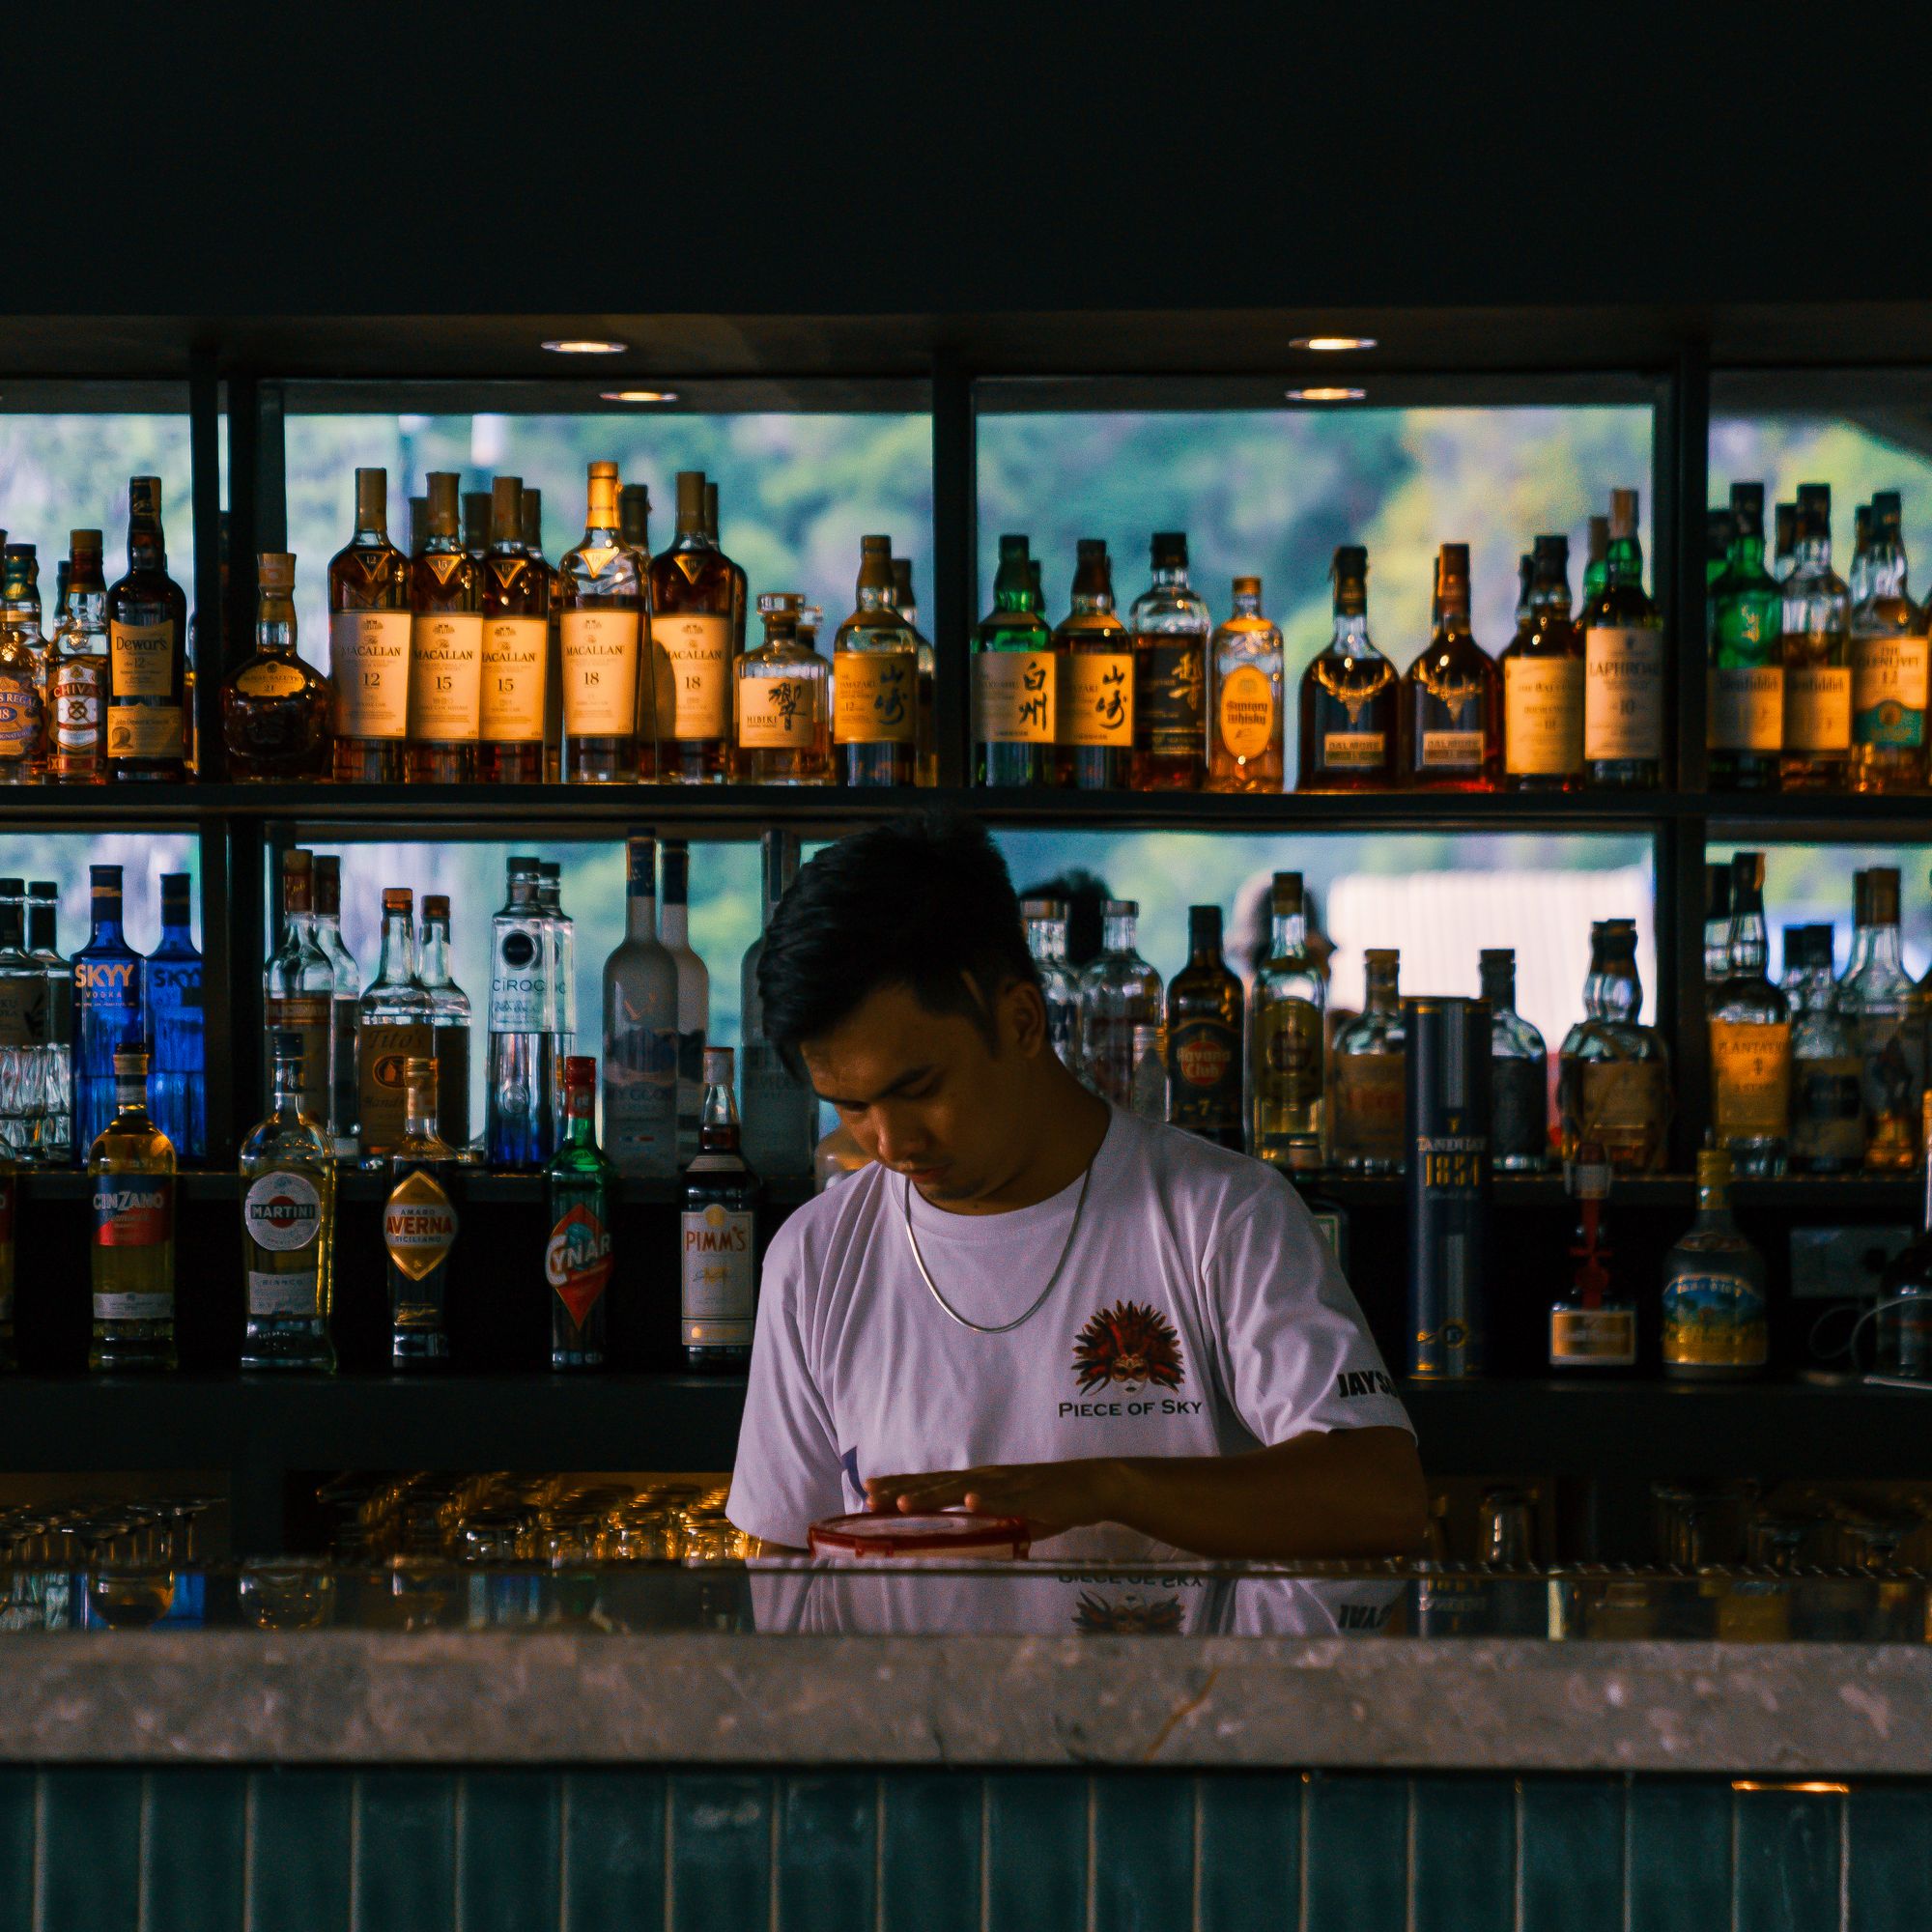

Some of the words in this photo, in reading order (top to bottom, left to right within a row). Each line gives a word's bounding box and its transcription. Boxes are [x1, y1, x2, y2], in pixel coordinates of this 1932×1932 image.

[115, 636, 168, 651] Dewar's
[565, 644, 624, 656] MACALLAN
[340, 646, 402, 657] MACALLAN
[413, 649, 473, 661] MACALLAN
[134, 657, 145, 668] 12
[362, 672, 381, 687] 12
[436, 676, 452, 691] 15
[497, 678, 514, 692] 15
[584, 671, 600, 686] 18
[686, 676, 701, 689] 18
[1018, 661, 1048, 731] 白州
[747, 716, 778, 724] HIBIKI
[74, 963, 135, 989] SKYY
[85, 990, 123, 999] VODKA
[92, 1190, 165, 1211] CINZANO
[252, 1205, 315, 1219] MARTINI
[385, 1216, 453, 1236] AVERNA
[686, 1226, 747, 1253] PIMM'S
